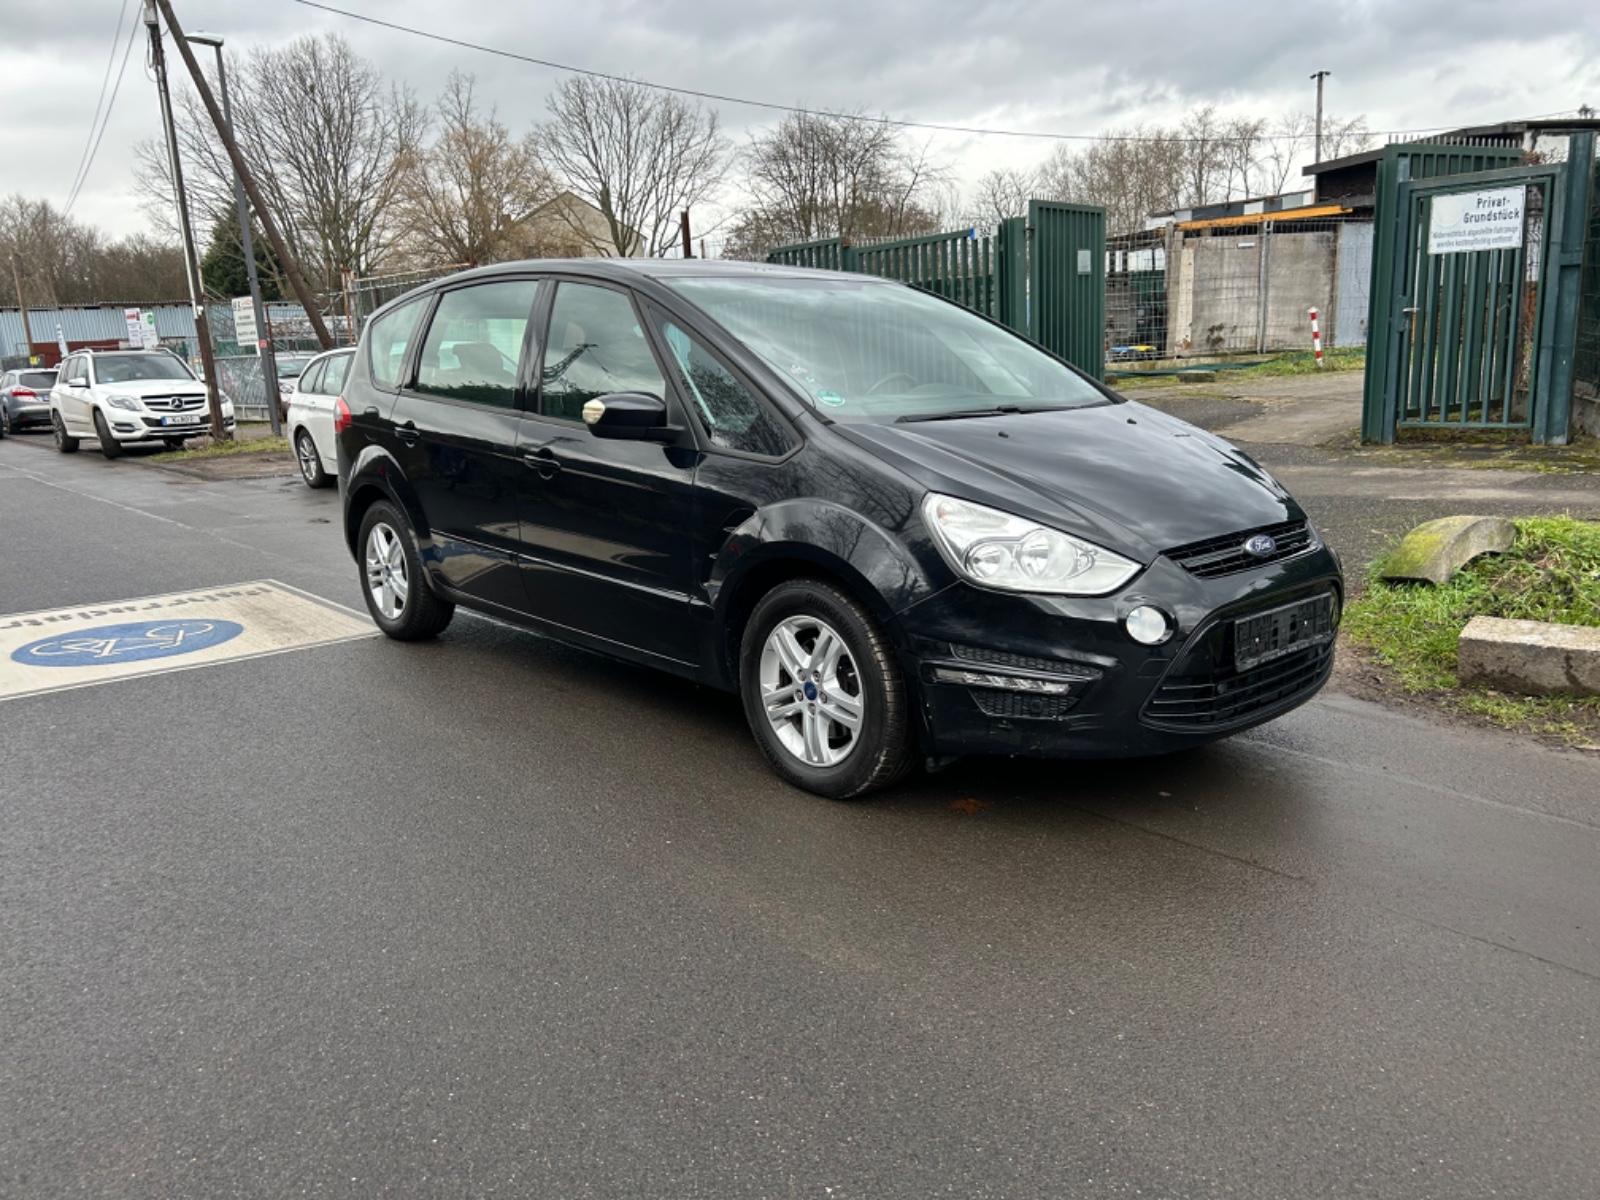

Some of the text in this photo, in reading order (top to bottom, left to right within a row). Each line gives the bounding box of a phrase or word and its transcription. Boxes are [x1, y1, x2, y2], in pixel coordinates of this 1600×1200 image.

[1476, 196, 1511, 209] Privat-
[1463, 207, 1520, 224] Grundstück
[1248, 537, 1273, 553] Ford
